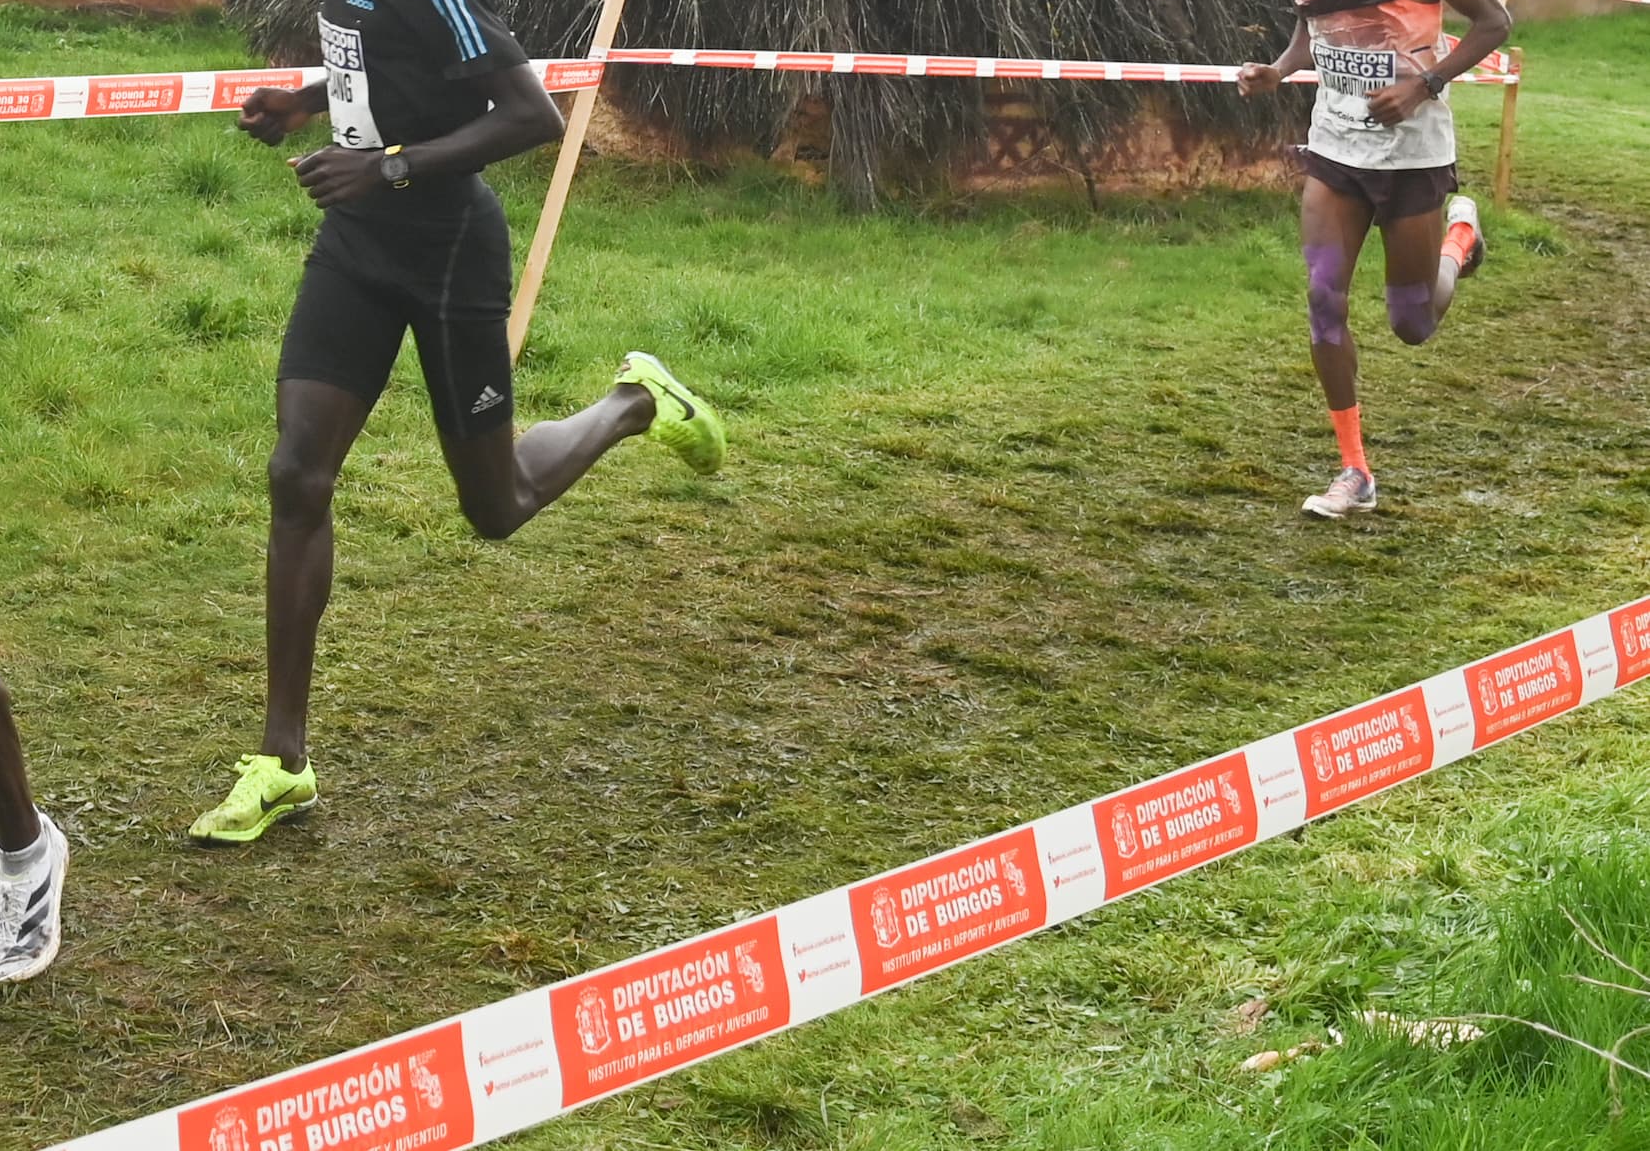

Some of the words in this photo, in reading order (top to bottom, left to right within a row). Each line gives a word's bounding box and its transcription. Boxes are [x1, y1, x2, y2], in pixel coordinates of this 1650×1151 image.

[1317, 55, 1389, 77] BURGOS
[17, 96, 29, 104] DE
[1495, 650, 1553, 688] DIPUTACIÓN
[1500, 689, 1515, 708] DE
[1517, 672, 1557, 701] BURGOS
[1331, 709, 1398, 751] DIPUTACIÓN
[1336, 752, 1354, 774] DE
[1357, 733, 1404, 766] BURGOS
[1136, 778, 1216, 825] DIPUTACIÓN
[1141, 825, 1162, 849] DE
[1166, 803, 1222, 840] BURGOS
[900, 857, 996, 910] DIPUTACIÓN
[905, 911, 930, 937] DE
[935, 885, 1002, 927] BURGOS
[882, 949, 921, 974] INSTITUTO
[922, 942, 942, 959] PARA
[944, 938, 952, 951] EL
[954, 926, 985, 947] DEPORTE
[988, 923, 992, 935] Y
[994, 908, 1029, 932] JUVENTUD
[613, 950, 730, 1012] DIPUTACIÓN
[617, 1012, 646, 1042] DE
[653, 980, 735, 1029] BURGOS
[588, 1054, 636, 1084] INSTITUTO
[638, 1046, 661, 1065] PARA
[664, 1041, 674, 1054] EL
[676, 1026, 715, 1052] DEPORTE
[717, 1023, 724, 1037] Y
[725, 1006, 768, 1034] JUVENTUD
[257, 1062, 401, 1134] DIPUTACIÓN
[306, 1095, 406, 1151] BURGOS
[396, 1122, 448, 1151] JUVENTUD
